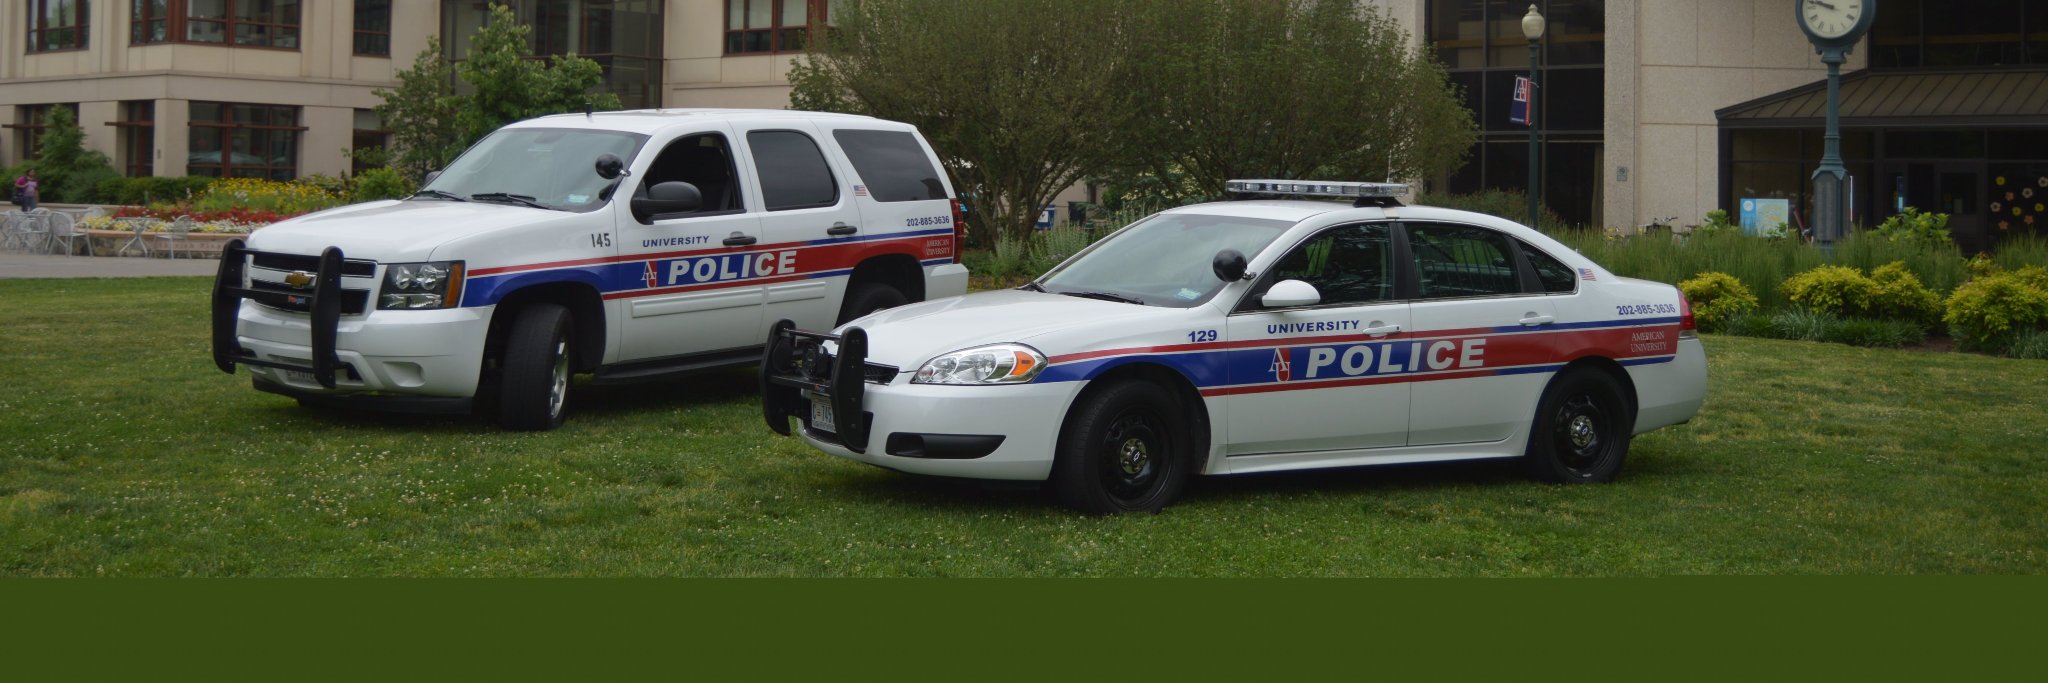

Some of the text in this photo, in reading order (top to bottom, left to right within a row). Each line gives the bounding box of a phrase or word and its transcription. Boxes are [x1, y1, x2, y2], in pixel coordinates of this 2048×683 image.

[906, 215, 950, 227] 202-885-3636
[591, 232, 611, 248] 145
[642, 235, 710, 248] UNIVERSITY
[667, 250, 797, 285] POLICE
[1616, 303, 1676, 316] 202-885-3636
[1267, 320, 1360, 334] UNIVERSITY
[1188, 329, 1218, 343] 129
[1631, 331, 1665, 342] AMERICAN
[1630, 342, 1667, 353] UNIVERSITY
[1305, 338, 1487, 379] POLICE
